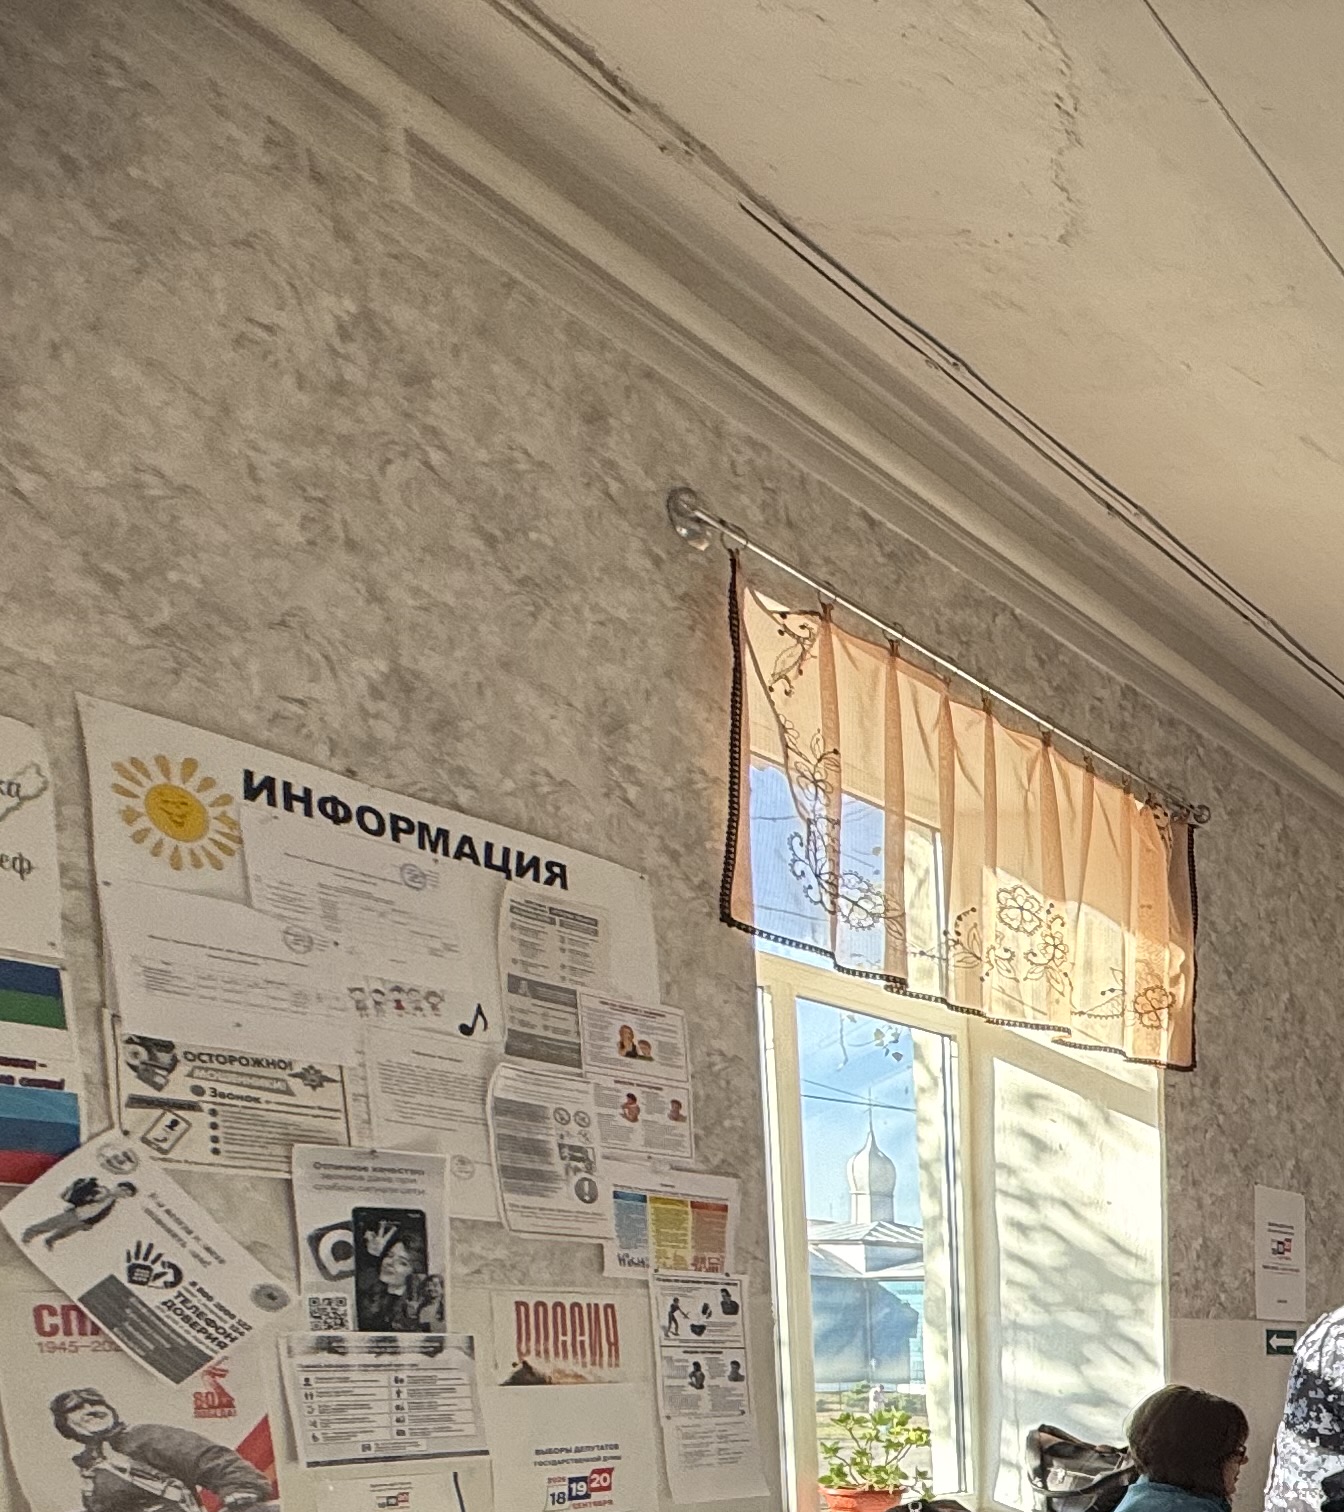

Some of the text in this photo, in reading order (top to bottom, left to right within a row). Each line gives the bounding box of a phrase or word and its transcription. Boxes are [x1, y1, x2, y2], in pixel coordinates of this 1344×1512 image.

[243, 769, 569, 890] ИНФОРМАЦИЯ
[183, 1050, 293, 1071] ОСТОРОЖНО!
[160, 1298, 229, 1351] ДОВЕРИЯ
[174, 1290, 239, 1344] ТЕЛЕФОН
[534, 1443, 620, 1456] ВЫБОРЫ ДЕПУТАТОВ
[550, 1472, 611, 1506] 18 19 20
